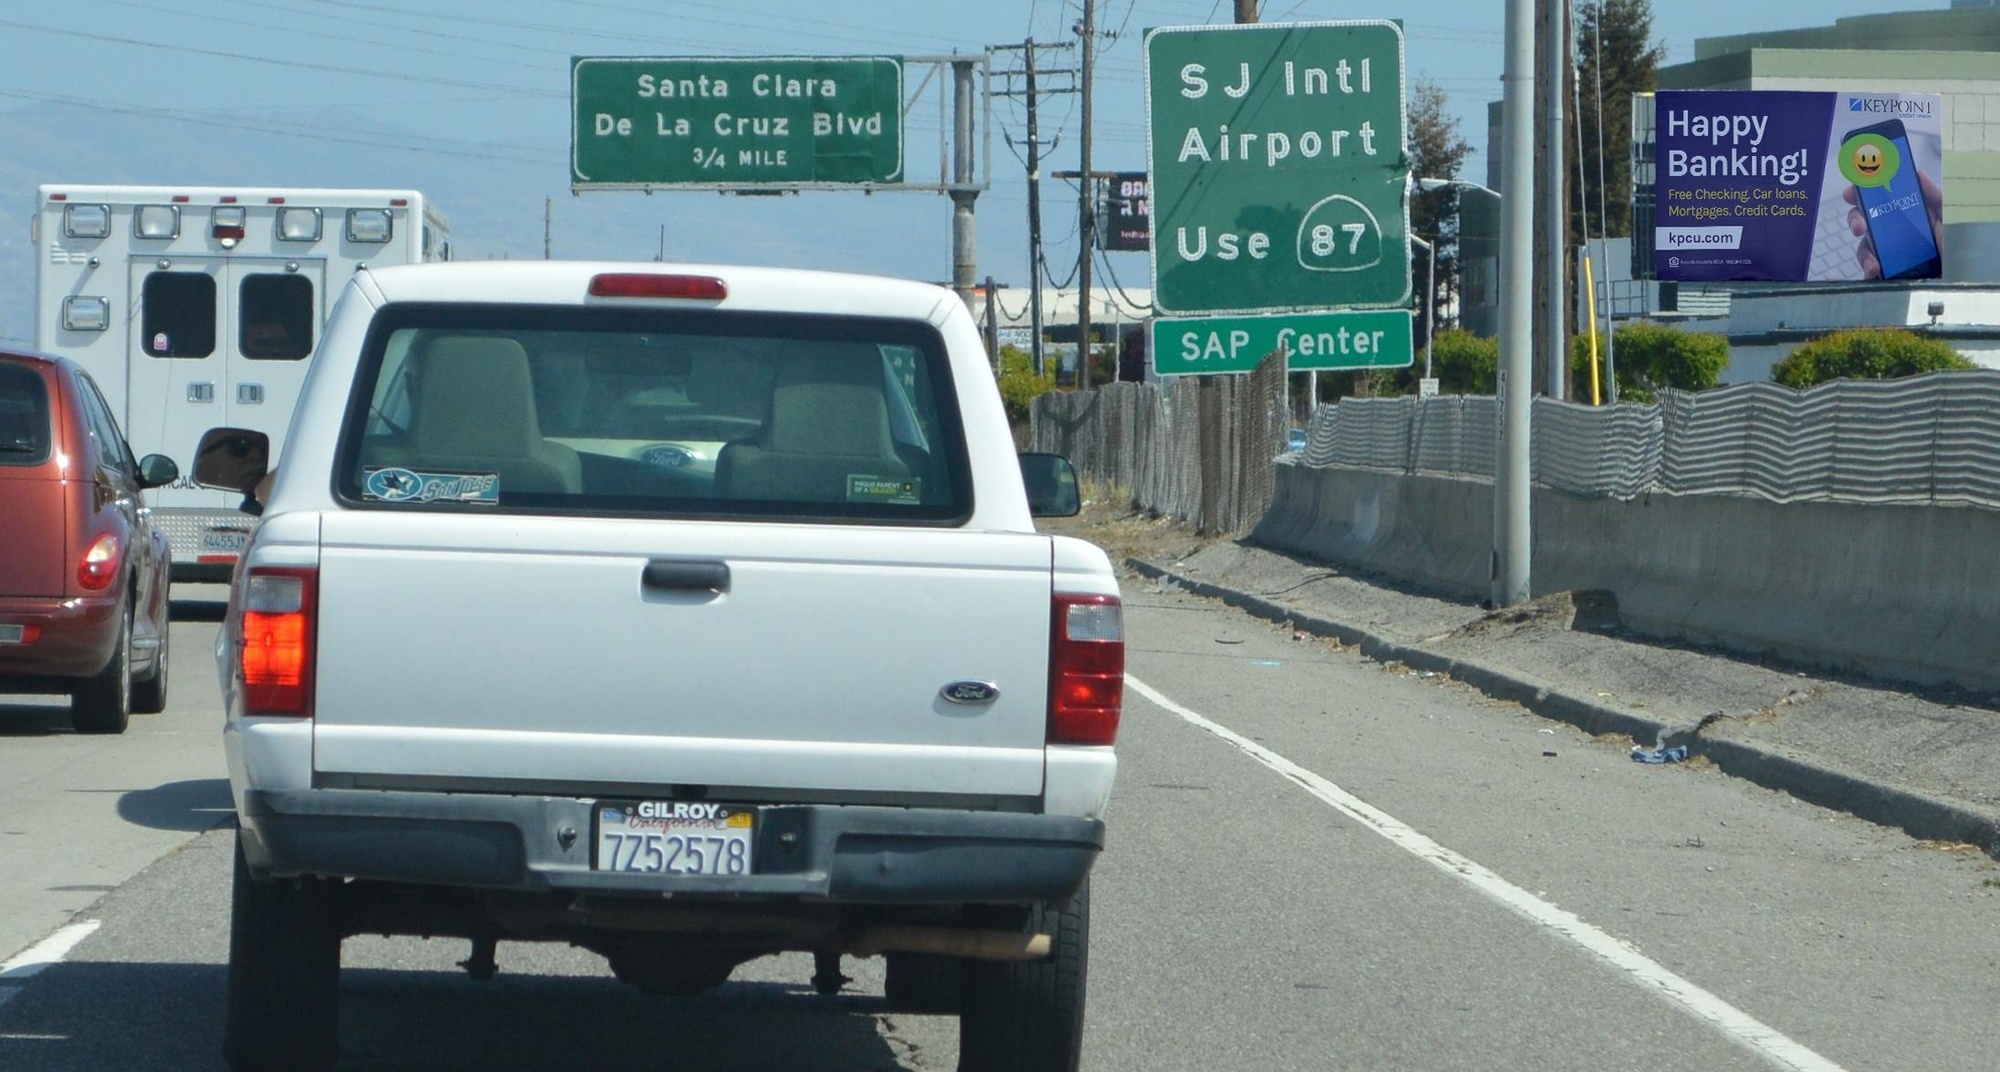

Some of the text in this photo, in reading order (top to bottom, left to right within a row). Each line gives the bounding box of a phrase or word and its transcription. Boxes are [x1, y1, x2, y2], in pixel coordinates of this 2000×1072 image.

[638, 74, 837, 98] Santa Clara
[1284, 57, 1371, 96] Intl
[595, 112, 882, 136] De La Cruz Blvd
[1668, 110, 1768, 145] Happy
[1178, 121, 1377, 166] Airport
[693, 148, 787, 168] 3/4 MILE
[1668, 148, 1808, 185] Banking!
[1668, 188, 1809, 203] Free Checking. Car loans.
[1668, 204, 1807, 220] Mortgages. Credit Cards.
[1177, 223, 1365, 262] Use 87
[1668, 230, 1733, 249] kpcu.com
[1181, 327, 1384, 361] SAP Center
[955, 685, 986, 699] Ford
[638, 802, 720, 820] GILROY
